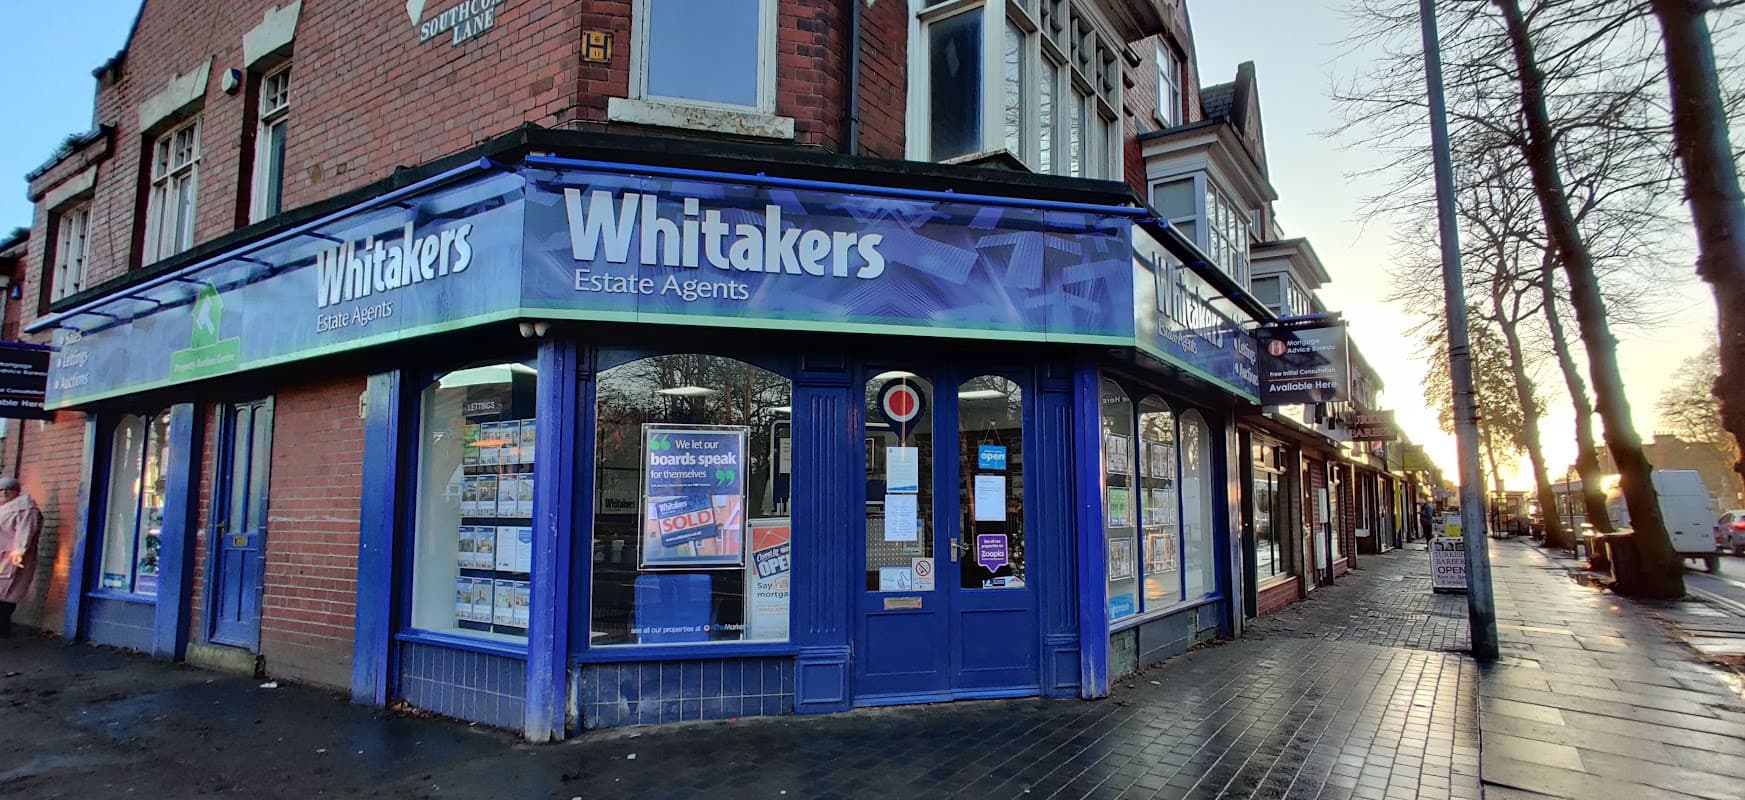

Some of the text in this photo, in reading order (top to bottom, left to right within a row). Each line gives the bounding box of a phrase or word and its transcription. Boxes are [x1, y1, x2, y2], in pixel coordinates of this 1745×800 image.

[420, 0, 502, 41] SOUTHCO
[452, 8, 494, 45] LANE
[586, 33, 608, 59] H
[564, 188, 885, 279] Whitakers
[316, 221, 473, 309] Whitakers
[575, 269, 749, 302] Estate Agents
[317, 301, 393, 333] Estate Agents
[1287, 338, 1320, 347] Mortgage
[1287, 346, 1311, 354] Advice
[1269, 381, 1337, 393] Available Here
[675, 439, 719, 449] We let our
[650, 452, 737, 467] boards speak
[981, 453, 1005, 462] open
[651, 470, 707, 479] for themselves
[662, 511, 711, 533] SOLD
[981, 550, 1005, 558] Zoopla
[758, 555, 789, 576] OPE
[1437, 566, 1466, 574] OPEN
[757, 582, 773, 592] Say
